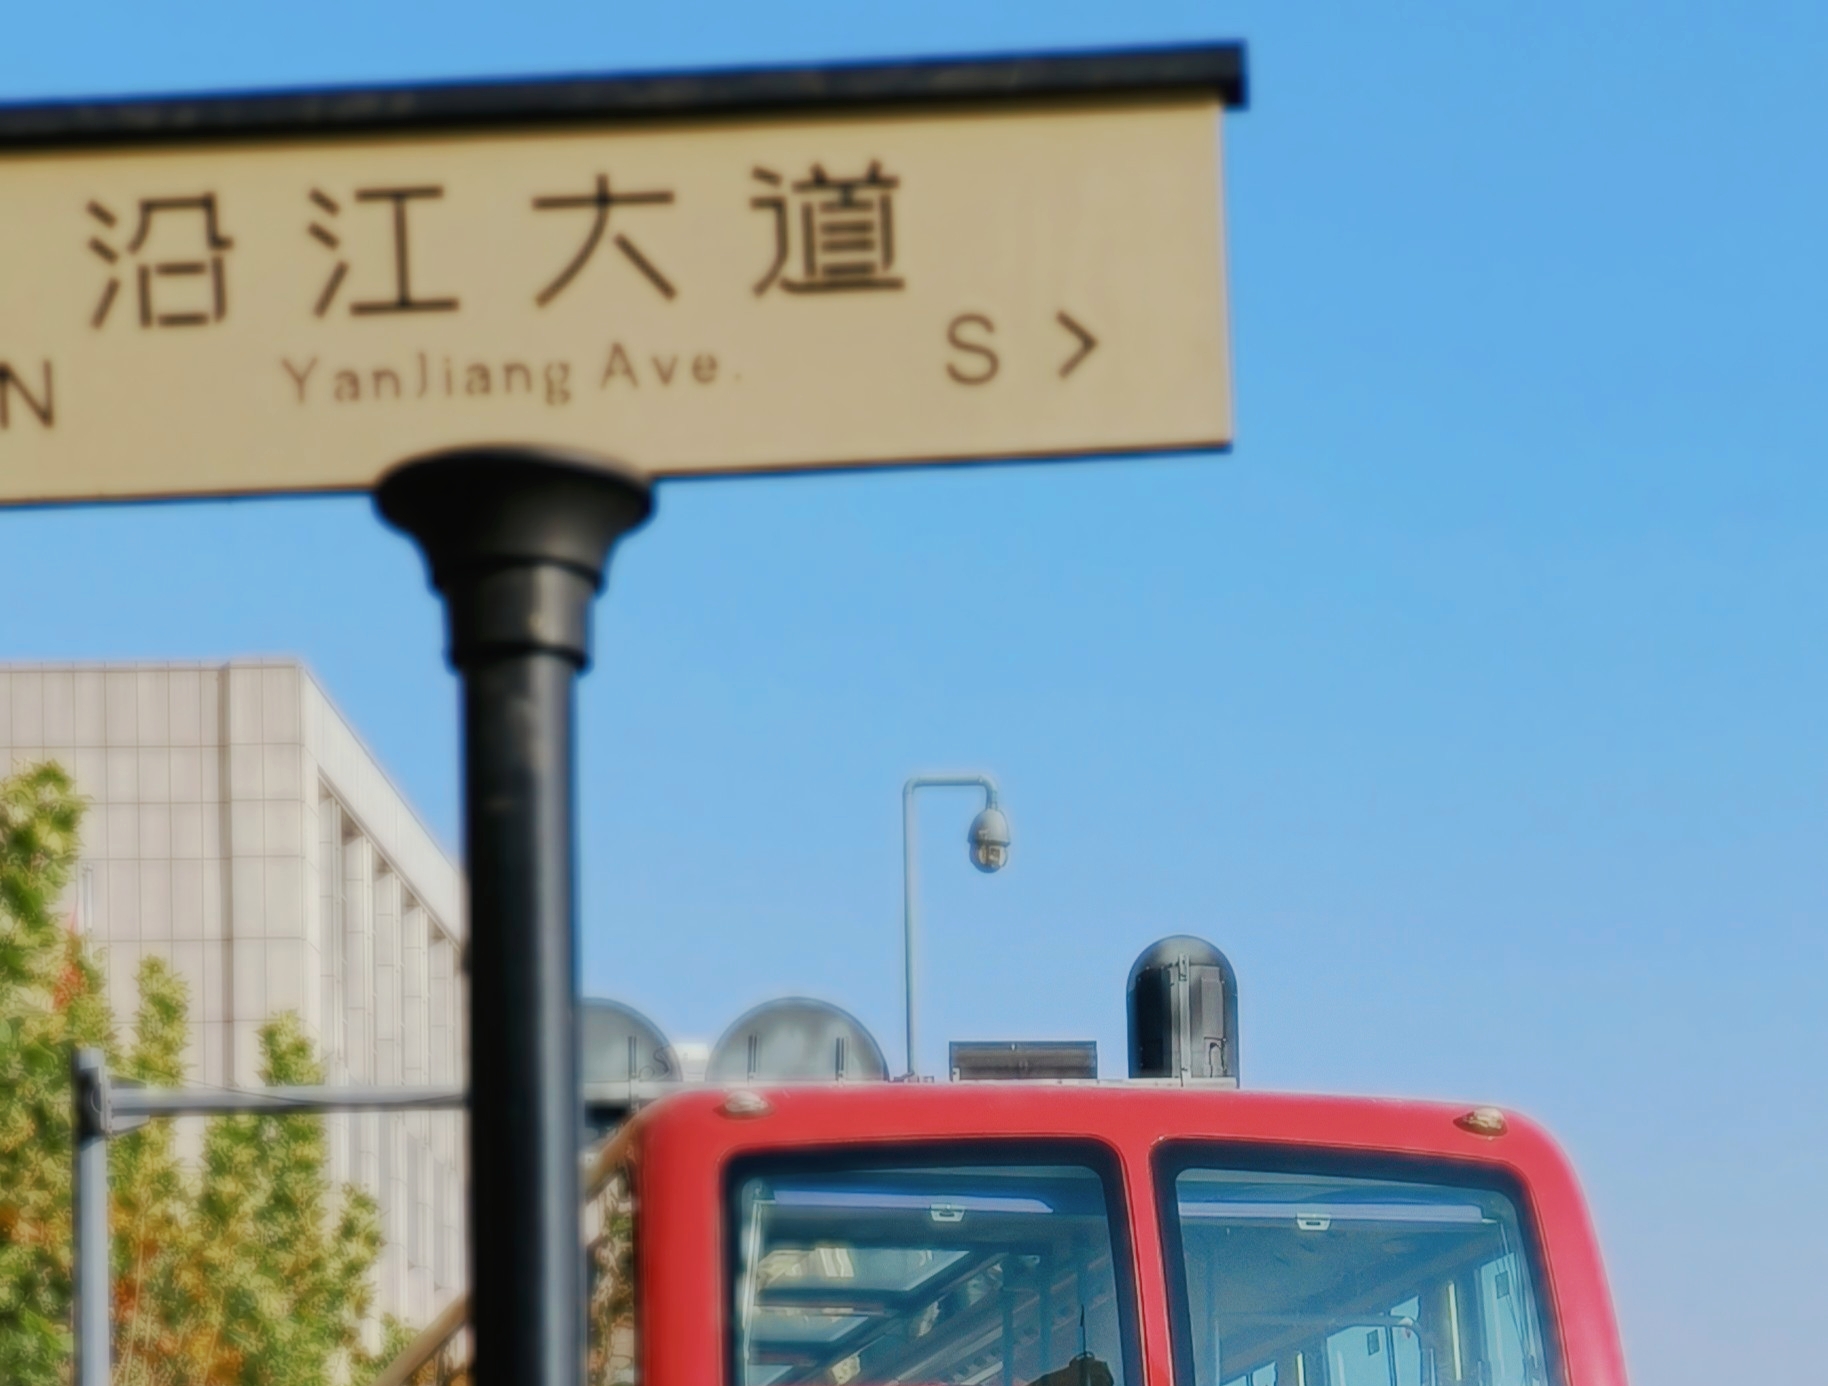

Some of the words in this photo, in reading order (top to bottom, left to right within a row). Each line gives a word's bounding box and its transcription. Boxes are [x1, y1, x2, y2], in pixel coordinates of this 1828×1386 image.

[87, 160, 905, 330] 沿江大道
[945, 313, 1000, 387] S
[0, 359, 55, 429] N
